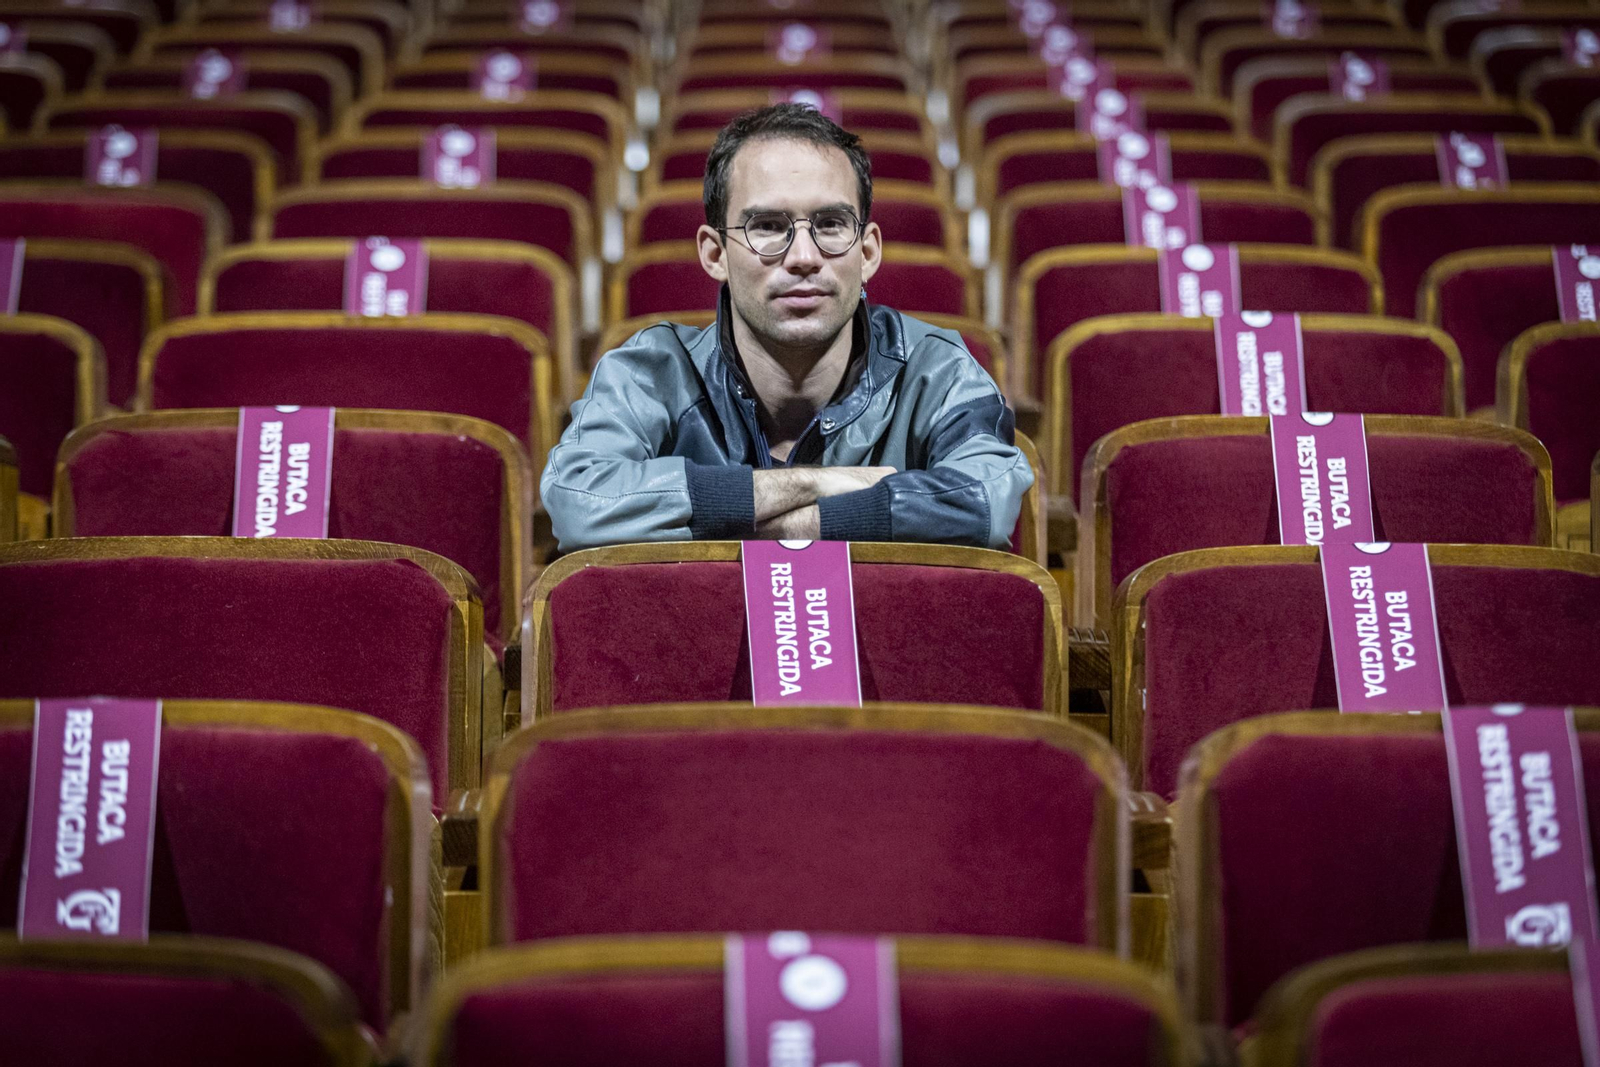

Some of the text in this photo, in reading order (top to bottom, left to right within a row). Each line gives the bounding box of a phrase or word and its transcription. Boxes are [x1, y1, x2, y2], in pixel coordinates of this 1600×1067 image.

[1236, 331, 1262, 416] RESTRING
[254, 421, 283, 538] RESTRINGIDA
[285, 442, 310, 515] BUTACA
[1327, 457, 1351, 530] BUTACA
[770, 562, 801, 696] RESTRINGIDA
[805, 588, 832, 670] BUTACA
[1349, 565, 1387, 698] RESTRINGIDA
[1385, 590, 1416, 672] BUTACA
[55, 708, 93, 878] RESTRINGIDA
[97, 739, 130, 846] BUTACA
[1476, 723, 1526, 894] RESTRINGIDA
[1519, 752, 1561, 860] BUTACA
